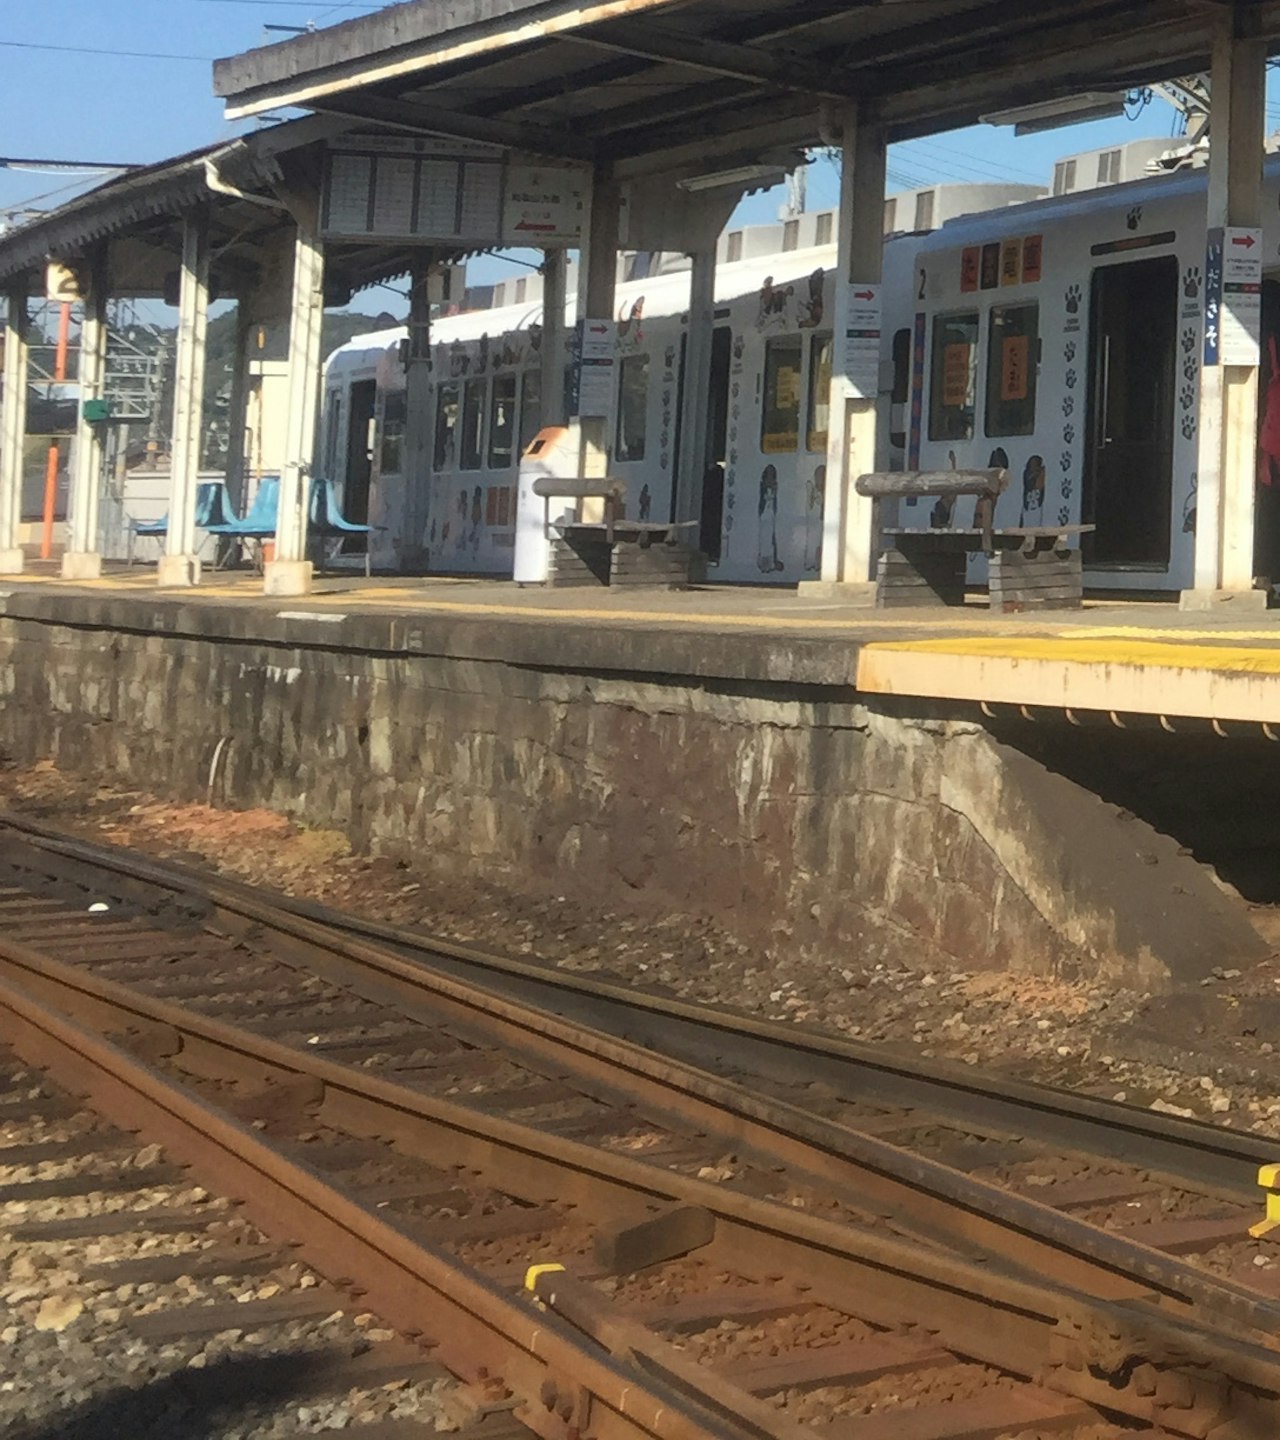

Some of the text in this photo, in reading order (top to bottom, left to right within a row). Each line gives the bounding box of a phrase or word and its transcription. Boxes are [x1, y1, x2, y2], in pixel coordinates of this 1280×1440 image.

[57, 263, 80, 294] 2
[1205, 244, 1221, 348] いだきそ
